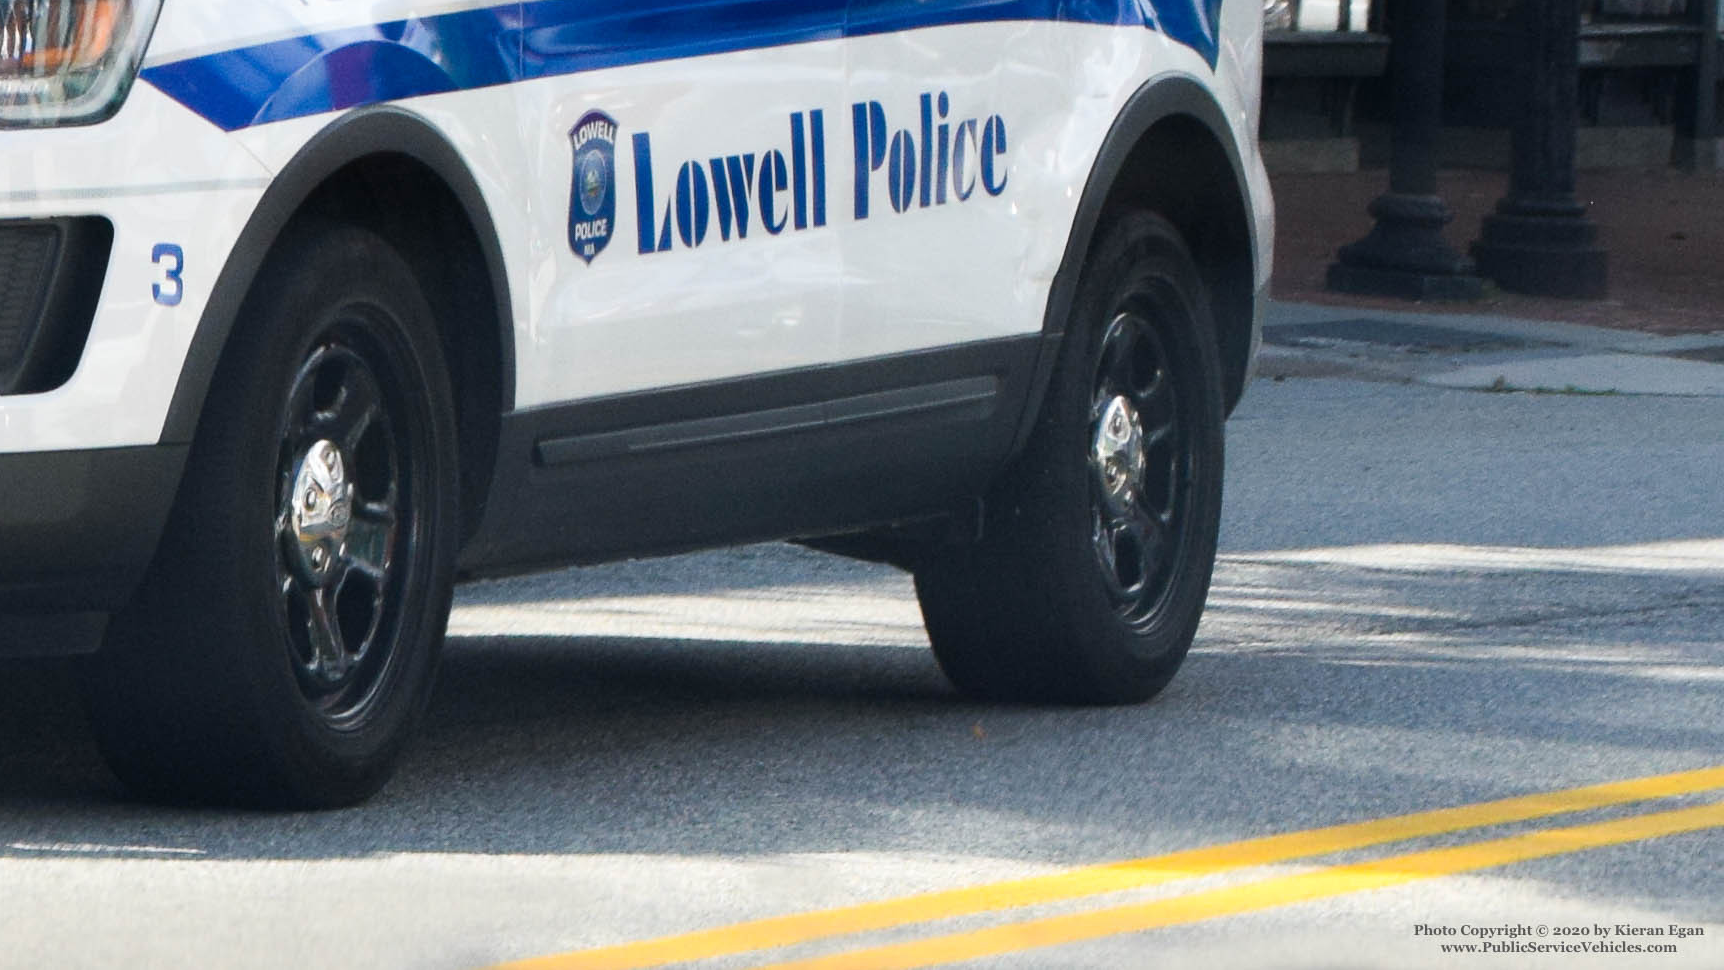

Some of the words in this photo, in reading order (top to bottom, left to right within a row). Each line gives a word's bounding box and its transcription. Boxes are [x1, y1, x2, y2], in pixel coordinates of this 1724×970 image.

[573, 120, 615, 150] LOWELL
[632, 108, 827, 255] Lowell
[852, 90, 1008, 221] Police
[575, 218, 607, 241] POLICE
[152, 243, 183, 307] 3
